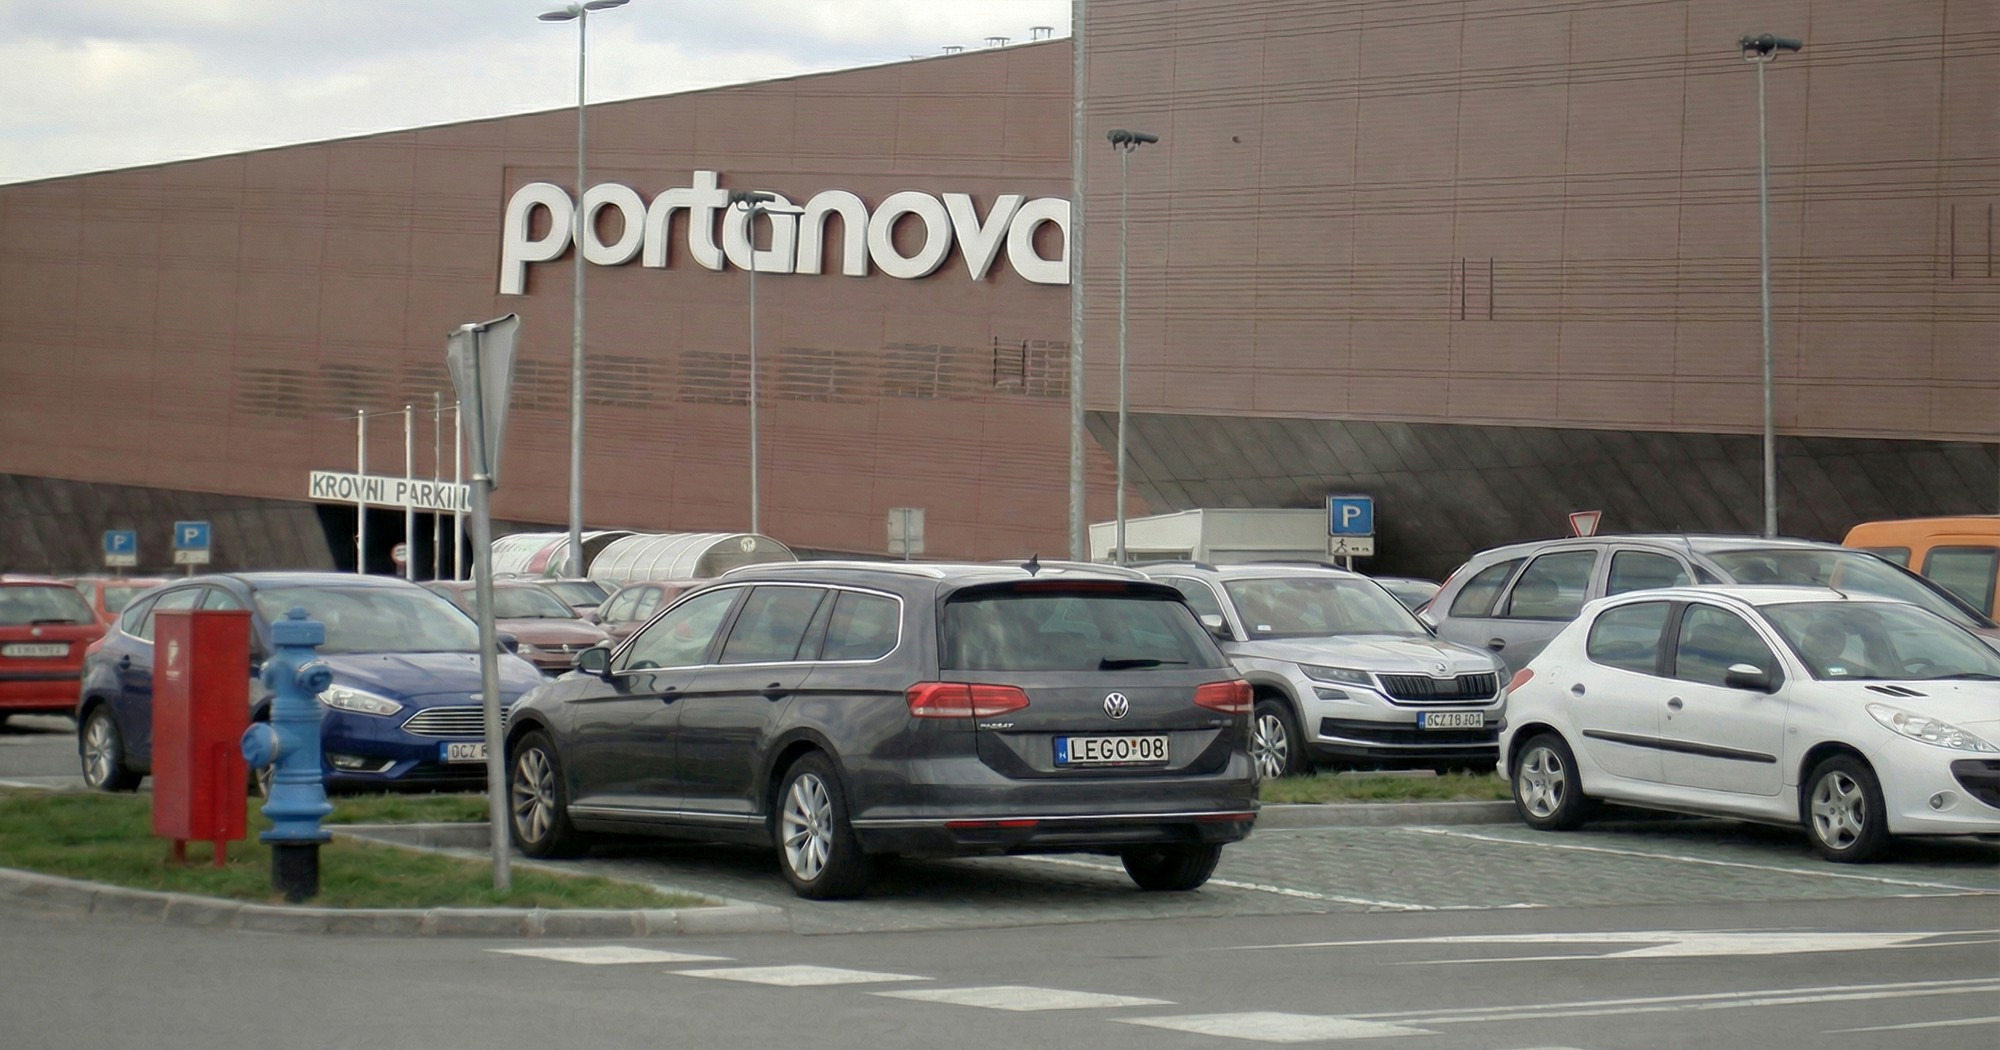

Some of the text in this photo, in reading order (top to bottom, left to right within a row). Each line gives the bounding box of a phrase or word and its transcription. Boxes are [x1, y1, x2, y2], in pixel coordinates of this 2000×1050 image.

[500, 170, 1072, 295] portanova
[313, 473, 472, 510] KROVNI PARKIN
[1342, 504, 1361, 528] P
[113, 535, 127, 550] P
[184, 528, 199, 545] P
[1070, 738, 1164, 760] LEGO 08
